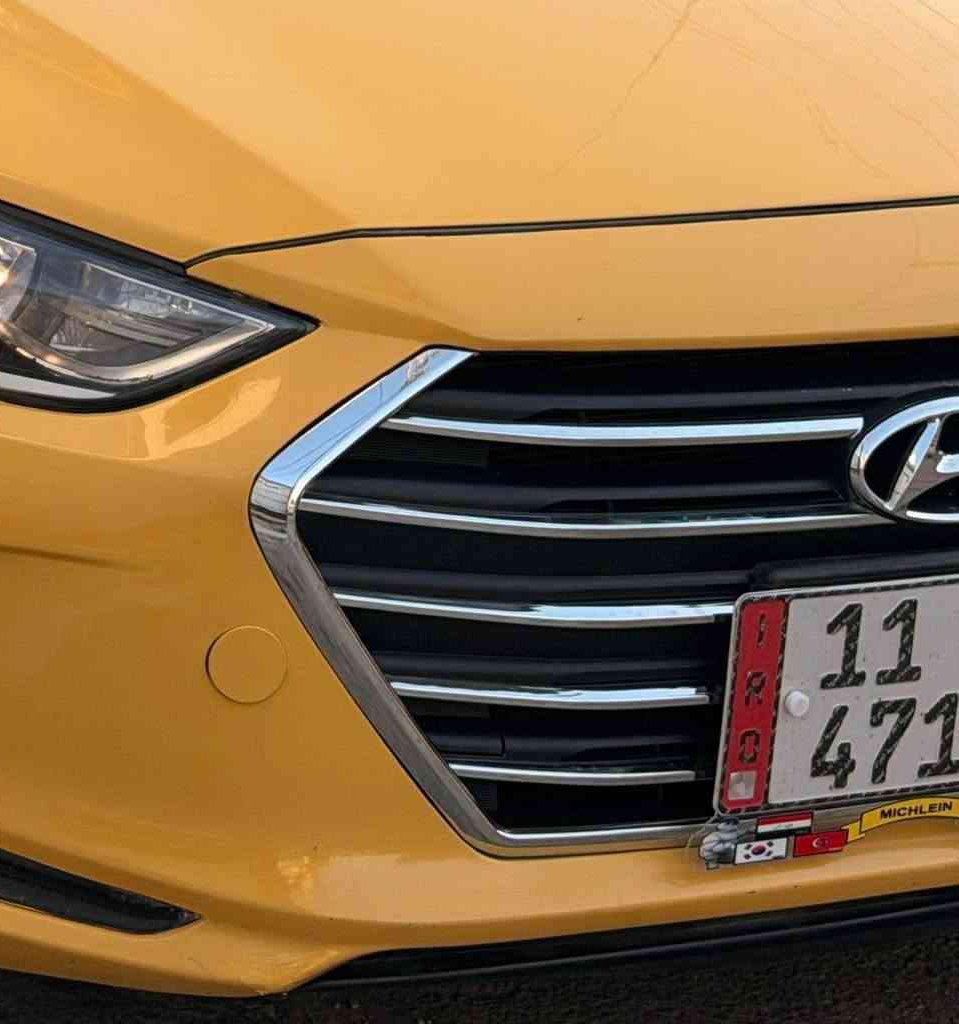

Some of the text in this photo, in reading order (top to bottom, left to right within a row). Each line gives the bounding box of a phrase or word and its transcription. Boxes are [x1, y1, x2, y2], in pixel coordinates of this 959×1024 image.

[820, 598, 922, 690] 11
[810, 692, 959, 789] 471
[880, 801, 953, 818] MICHLEIN
